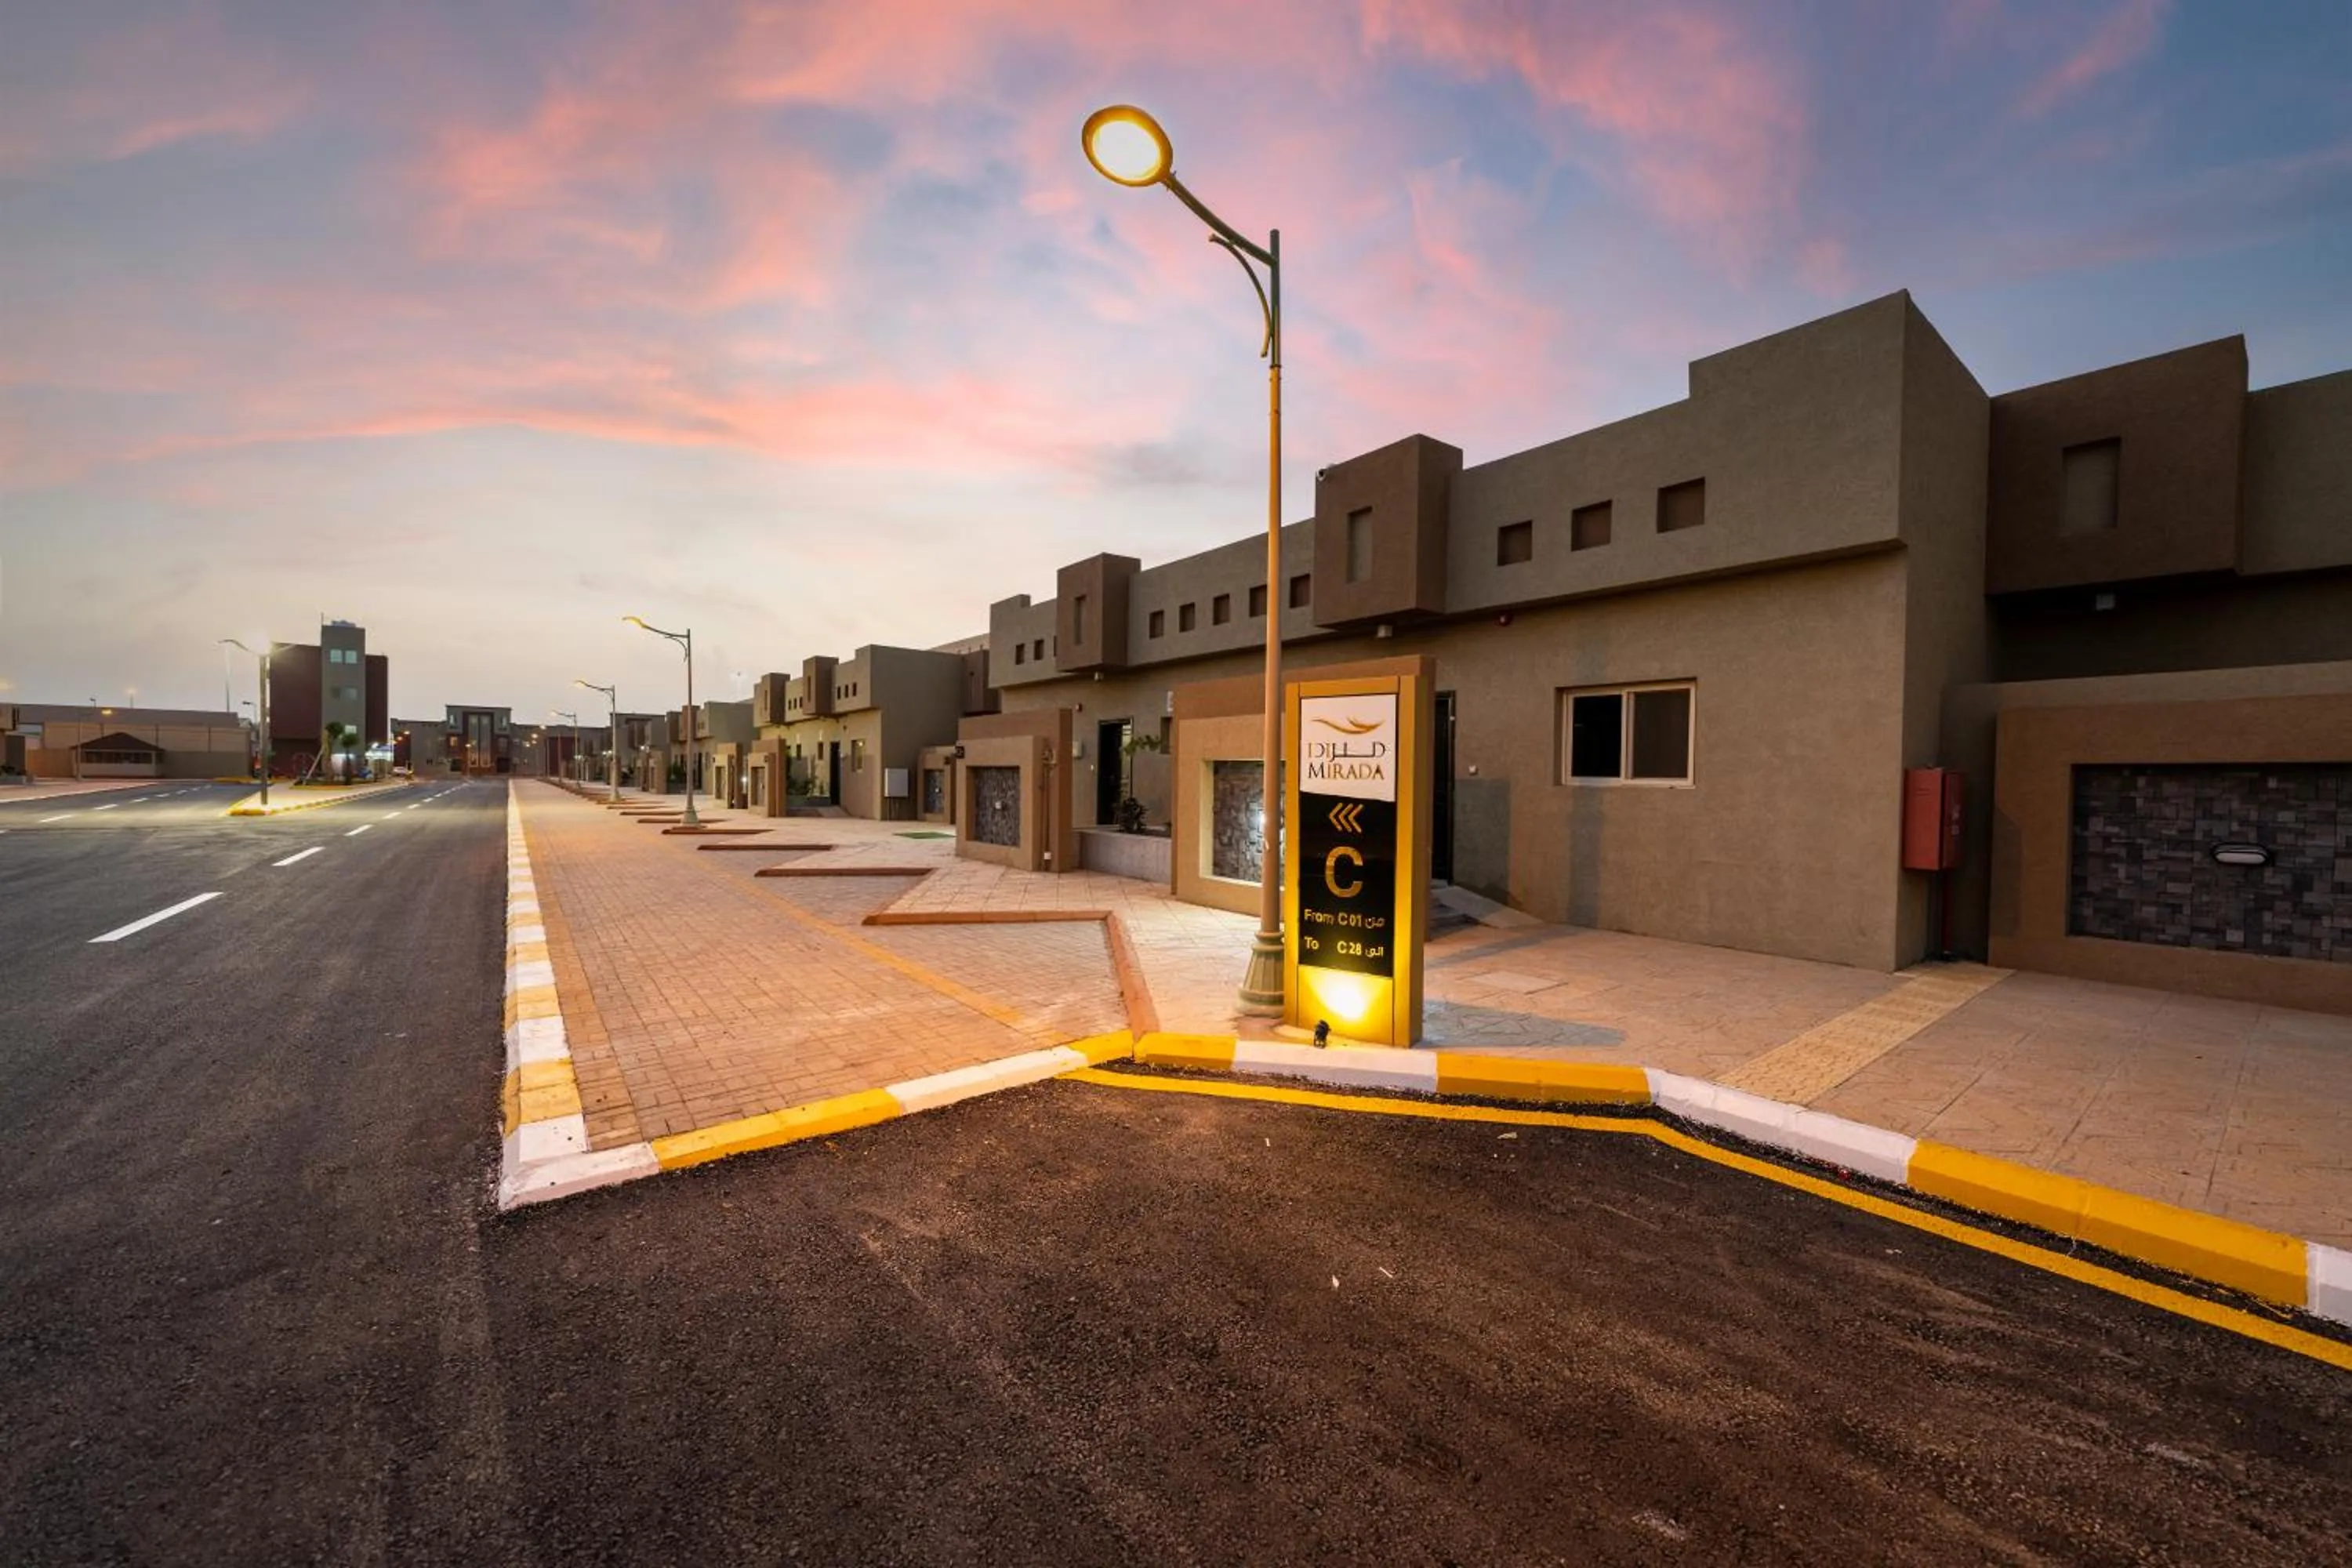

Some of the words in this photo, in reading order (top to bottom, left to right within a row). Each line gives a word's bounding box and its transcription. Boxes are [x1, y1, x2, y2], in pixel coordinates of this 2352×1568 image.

[1308, 761, 1385, 780] MIRADA
[1325, 846, 1363, 898] C
[1304, 909, 1334, 925] From
[1365, 916, 1385, 929] من
[1304, 936, 1319, 950] To
